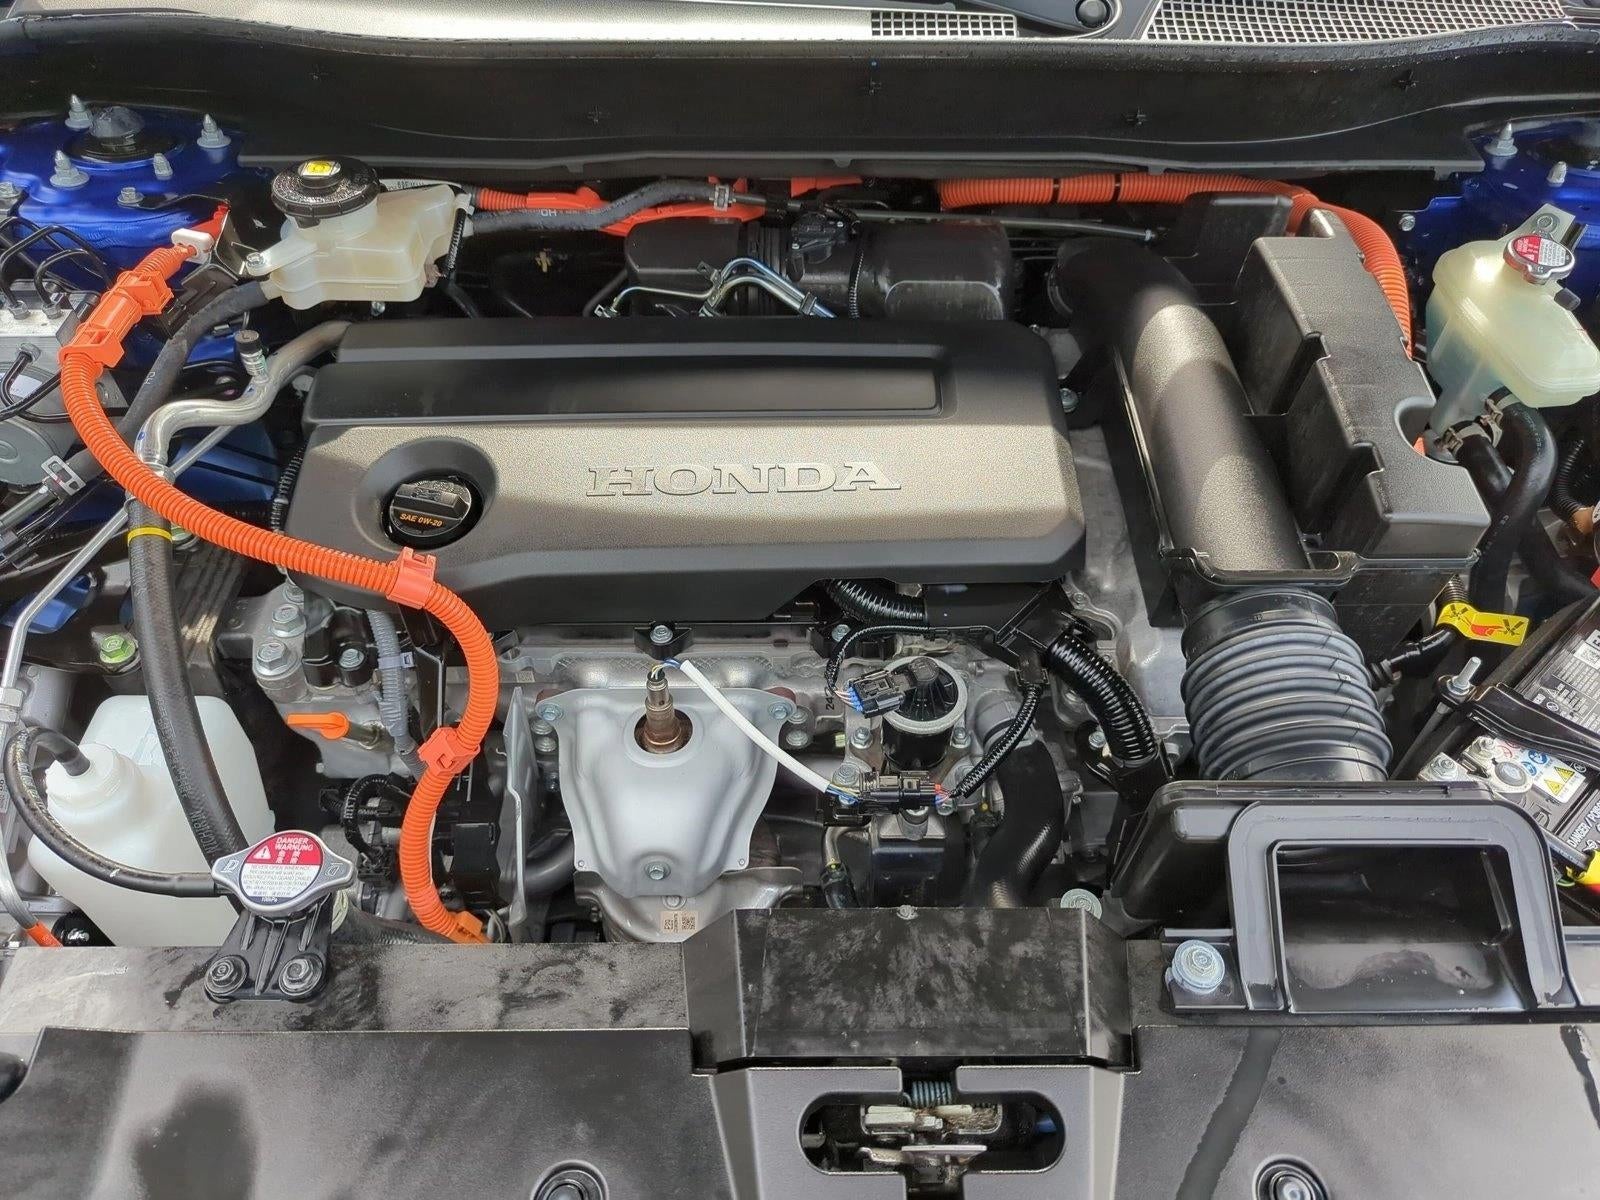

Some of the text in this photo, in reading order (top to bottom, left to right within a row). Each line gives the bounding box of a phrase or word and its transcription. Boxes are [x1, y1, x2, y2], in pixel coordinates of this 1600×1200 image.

[586, 462, 901, 497] HONDA
[400, 513, 443, 527] SAE 0W-20
[1566, 822, 1591, 848] DANGER
[274, 843, 314, 852] WARNUNG
